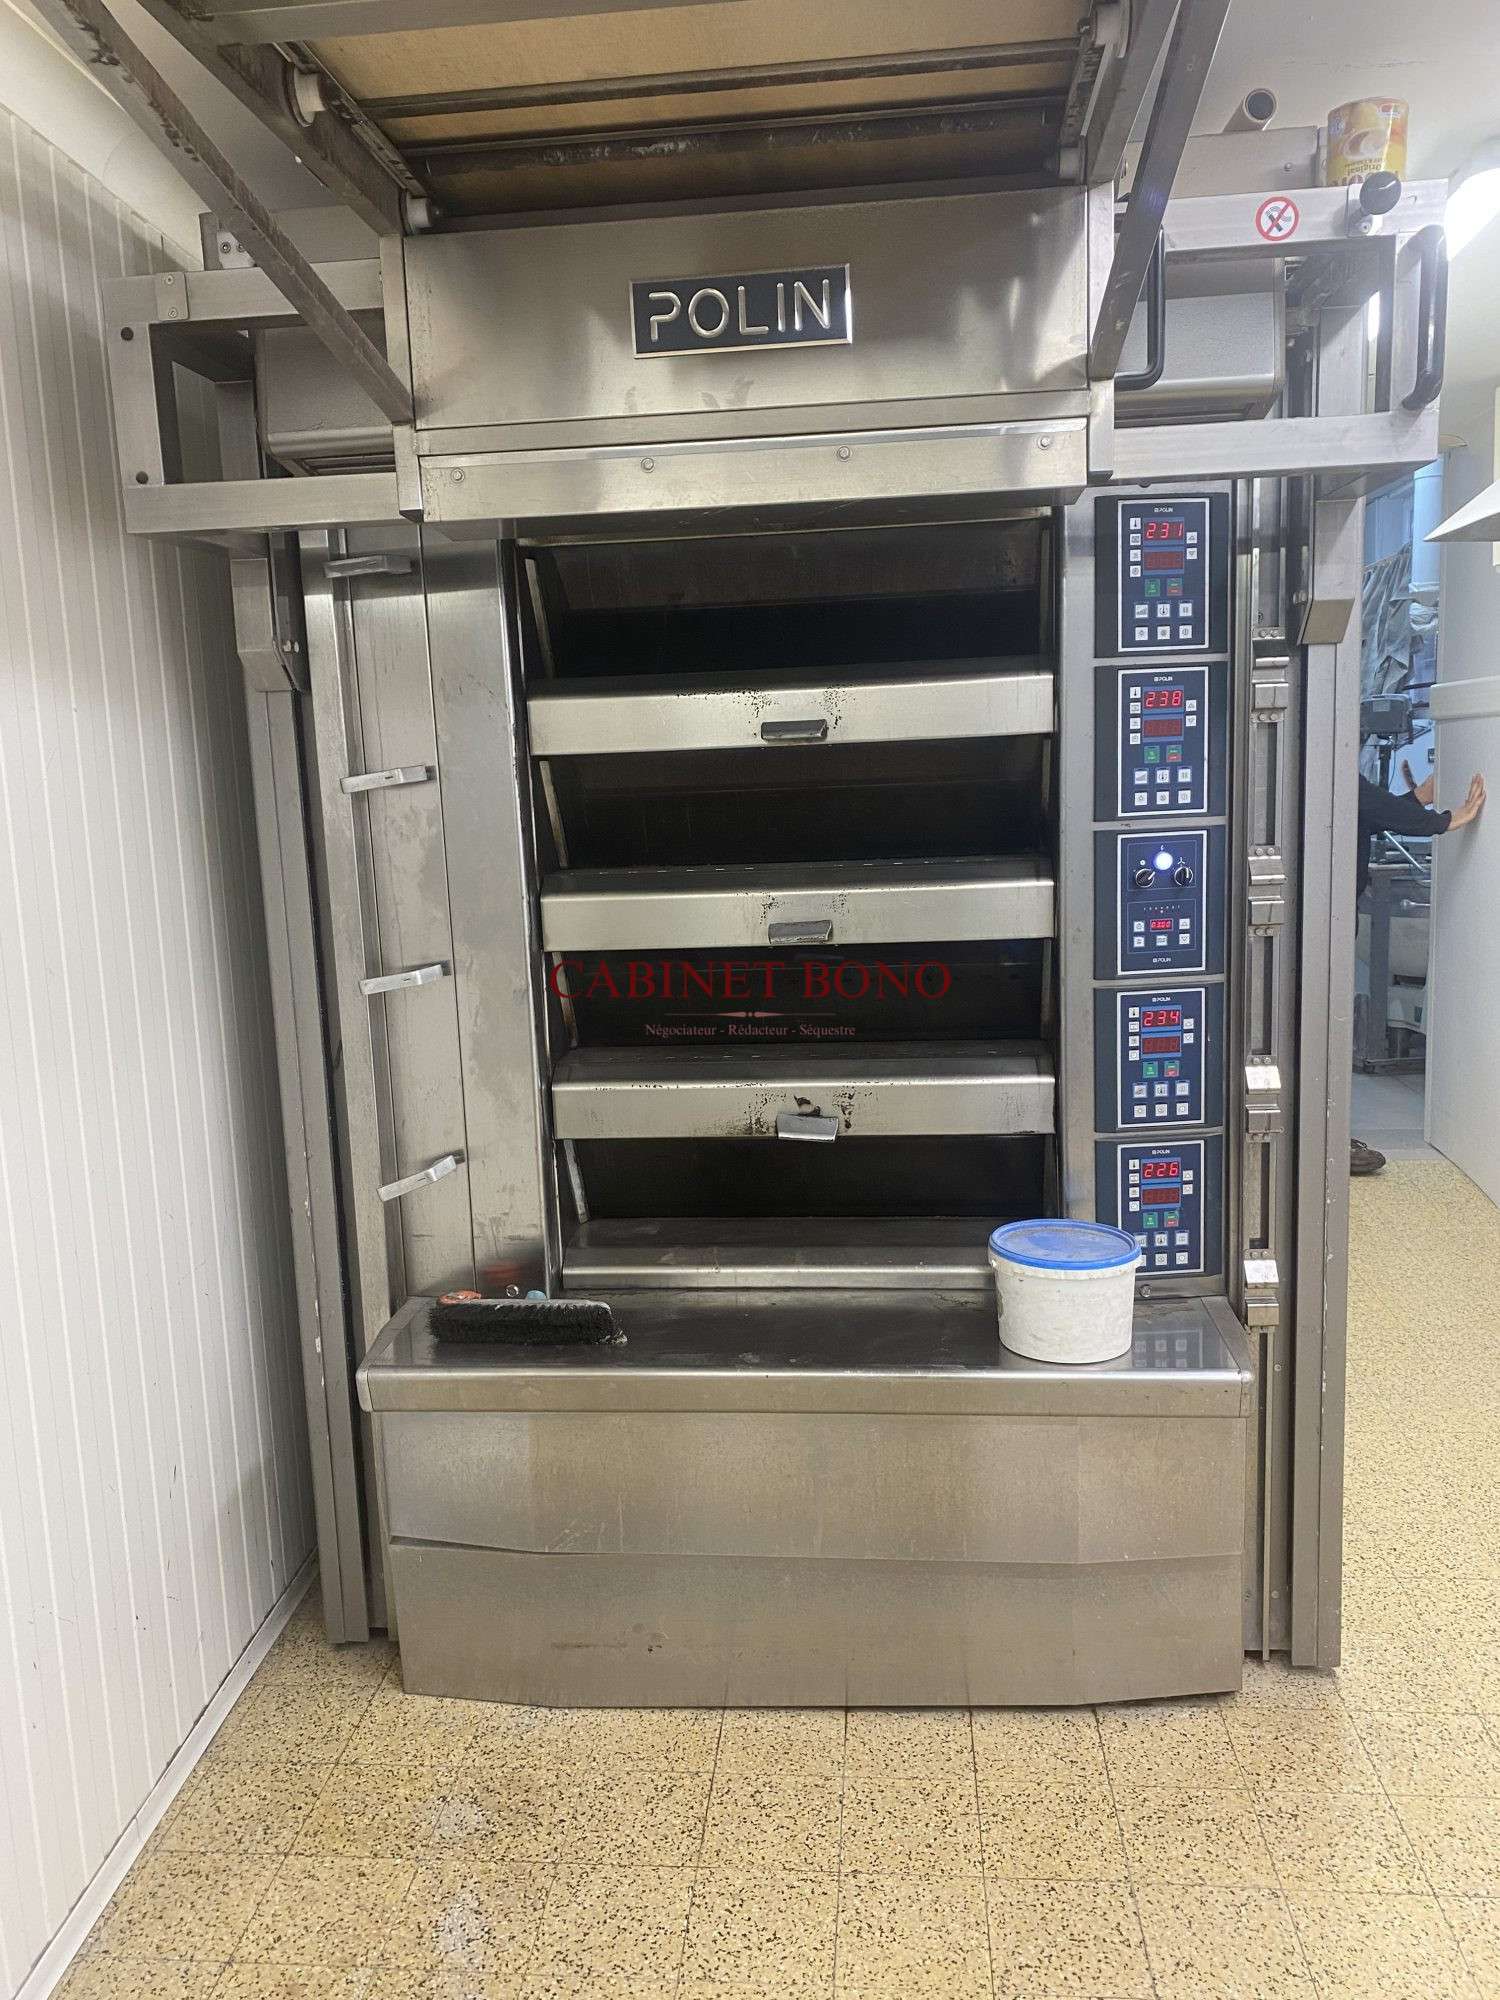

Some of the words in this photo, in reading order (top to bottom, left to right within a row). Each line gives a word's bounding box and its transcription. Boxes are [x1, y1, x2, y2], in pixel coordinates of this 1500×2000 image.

[649, 279, 831, 343] POLIN
[1146, 523, 1184, 538] 231
[1145, 691, 1183, 707] 238
[1144, 1010, 1180, 1026] 234
[1144, 1162, 1179, 1177] 226
